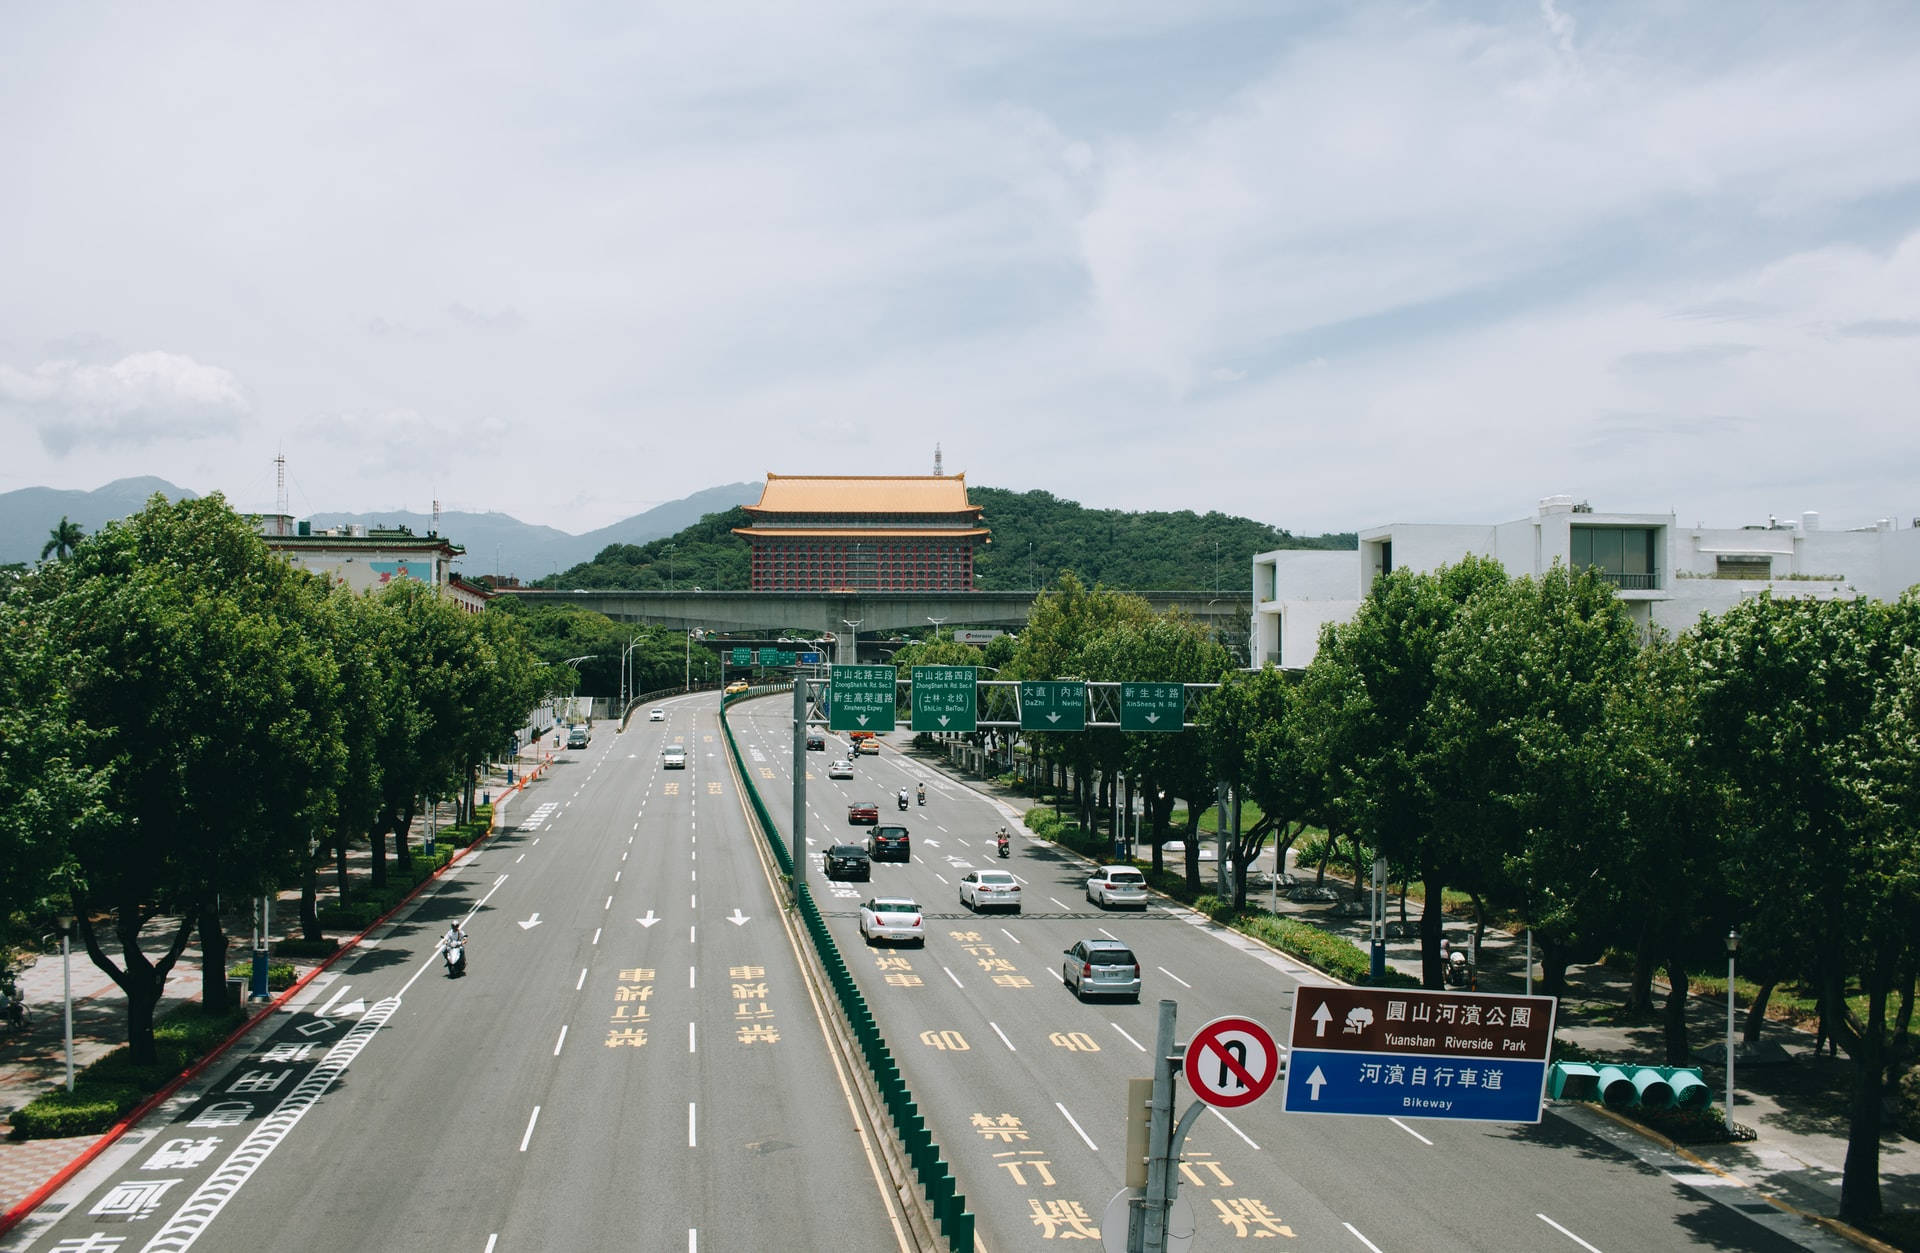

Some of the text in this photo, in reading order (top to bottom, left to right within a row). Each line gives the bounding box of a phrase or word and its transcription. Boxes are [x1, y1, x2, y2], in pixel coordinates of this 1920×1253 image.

[833, 669, 893, 680] 中山北路三段
[915, 670, 973, 681] 中山北路四段
[916, 682, 943, 690] ZhongShan
[1023, 686, 1046, 696] 大直
[1125, 687, 1179, 698] 新生北路
[833, 692, 893, 703] 新生高架道路
[949, 931, 1034, 988] 禁行機車
[1386, 1000, 1531, 1028] 圓山河濱公園
[919, 1030, 971, 1052] 40
[1048, 1031, 1101, 1053] 40
[1384, 1033, 1526, 1052] Yuanshan Riverside Park
[1359, 1062, 1504, 1091] 河濱自行車道
[1403, 1097, 1452, 1110] Bikeway
[1174, 1119, 1298, 1240] 行機
